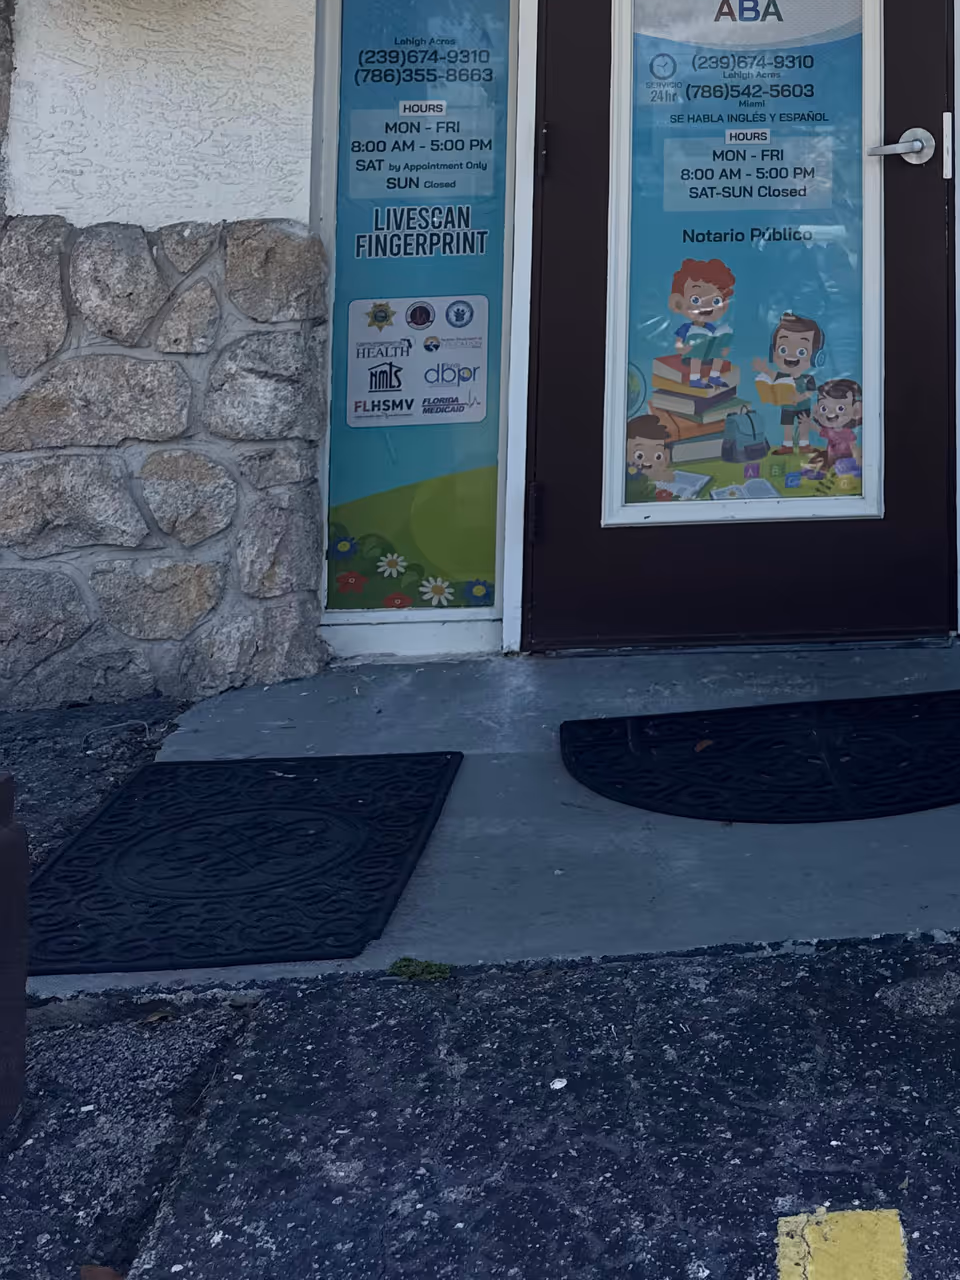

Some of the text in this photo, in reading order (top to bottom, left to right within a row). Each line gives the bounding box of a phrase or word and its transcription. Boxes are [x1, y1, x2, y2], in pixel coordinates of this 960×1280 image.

[358, 49, 490, 68] (239)674-9310
[692, 54, 814, 72] (239)674-9310
[354, 68, 494, 86] (786)355-8663
[685, 83, 814, 101] (786)542-5603
[403, 104, 444, 114] HOURS
[739, 100, 765, 108] Miami
[670, 110, 829, 123] SE HABLA INGLÉS Y ESPAÑOL
[385, 122, 421, 134] MON
[436, 121, 460, 133] FRI
[729, 132, 767, 141] HOURS
[351, 140, 387, 153] 8:00
[391, 140, 415, 152] AM
[430, 139, 465, 151] 5:00
[470, 138, 493, 151] PM
[712, 150, 746, 162] MON
[761, 149, 784, 161] FRI
[355, 159, 488, 173] SAT by Appointment Only
[680, 169, 715, 180] 8:00
[719, 168, 741, 180] AM
[756, 168, 788, 179] 5:00
[793, 167, 815, 178] PM
[386, 177, 456, 190] SUN Closed
[689, 185, 807, 198] SAT-SUN Closed
[374, 206, 471, 231] LIVESCAN
[683, 227, 813, 243] Notario Público
[355, 230, 489, 258] FINGERPRINT
[356, 346, 411, 359] HEALTH
[424, 363, 480, 387] dbpr
[354, 398, 414, 413] FLHSMV
[422, 396, 459, 404] FLORIDA
[422, 406, 465, 414] MEDICAID
